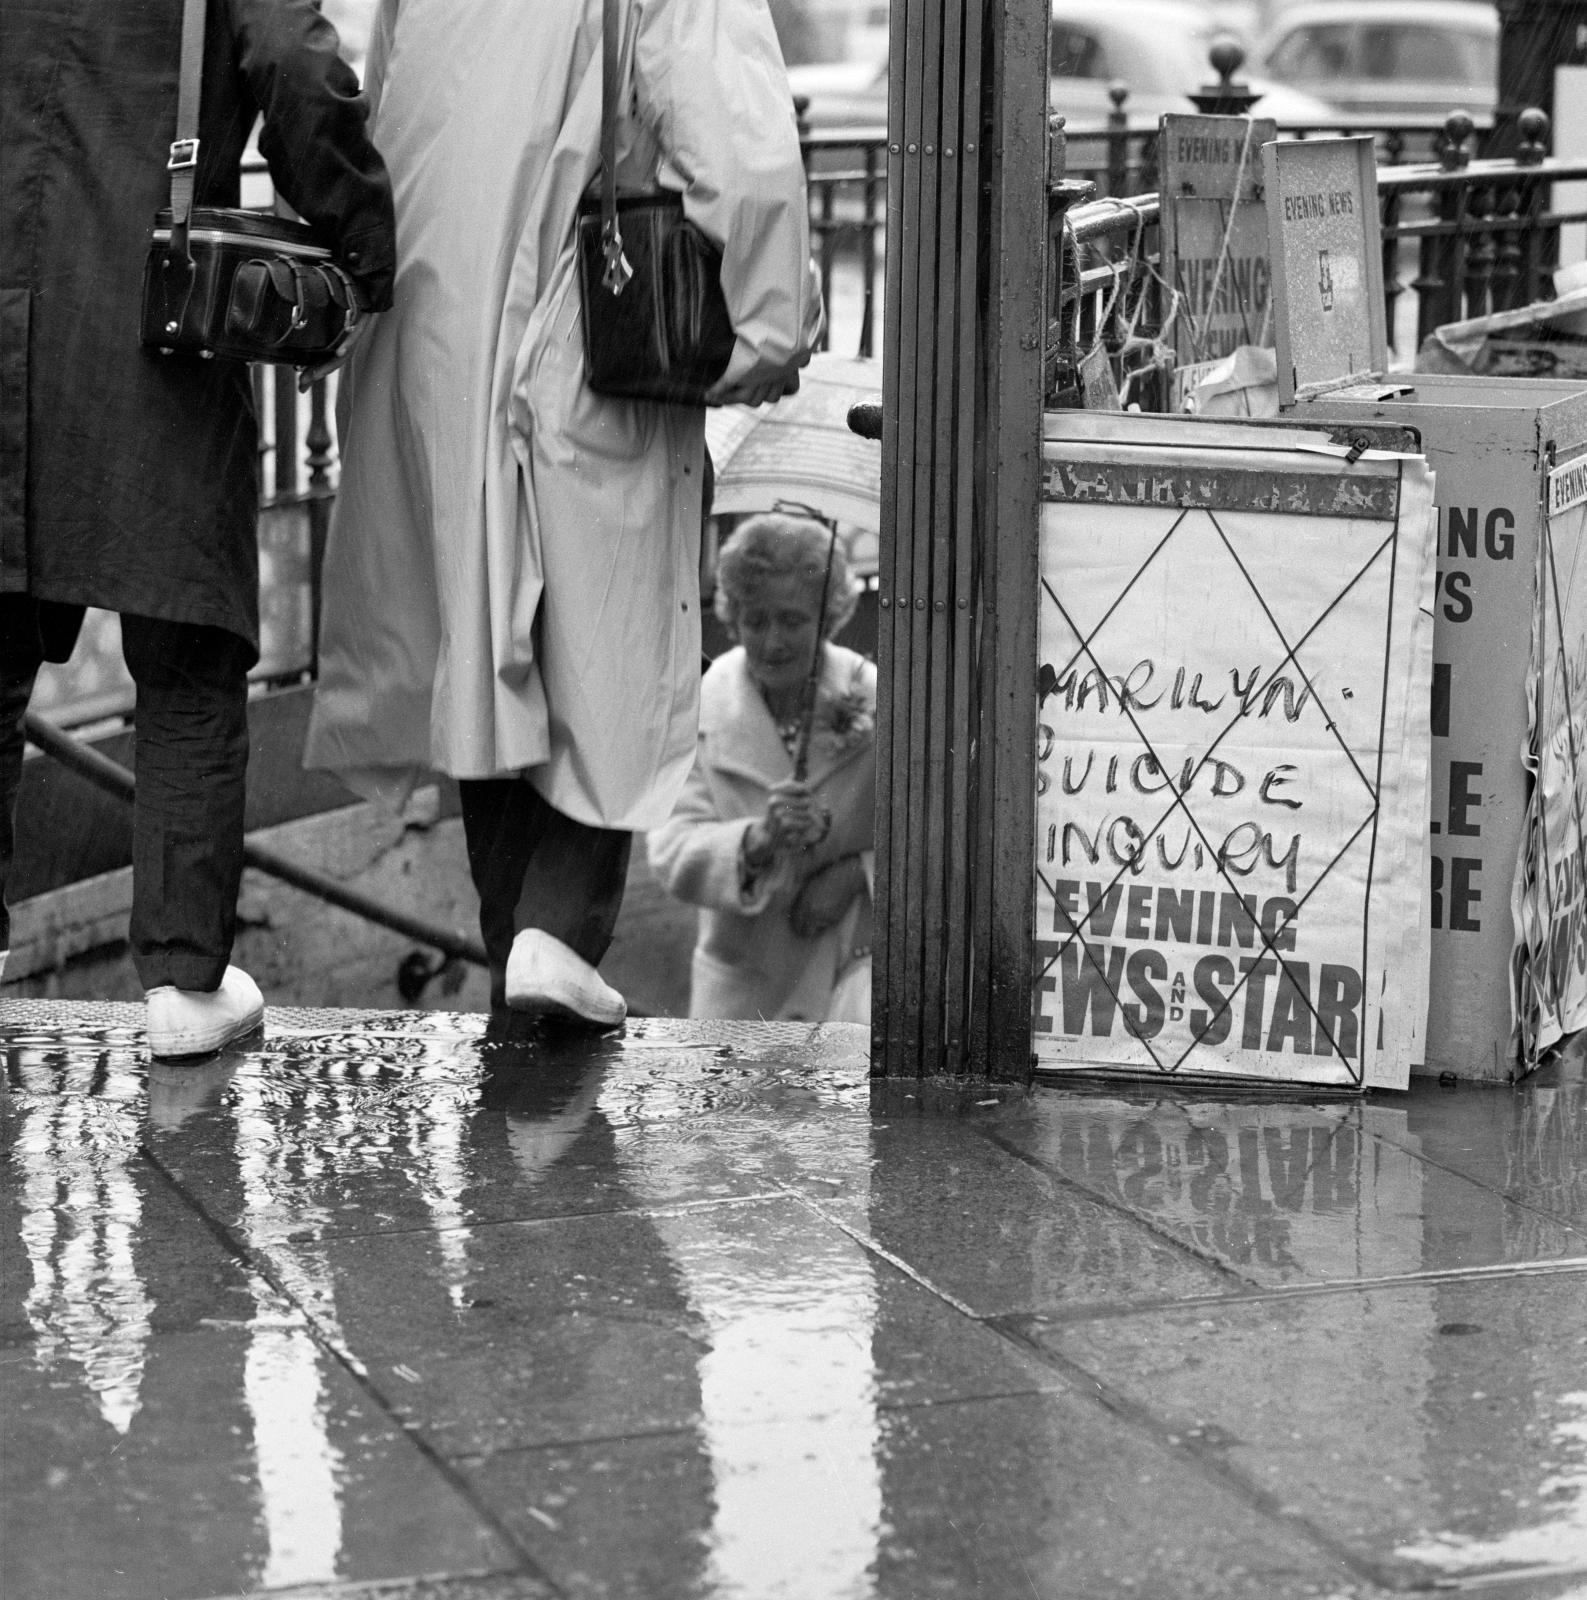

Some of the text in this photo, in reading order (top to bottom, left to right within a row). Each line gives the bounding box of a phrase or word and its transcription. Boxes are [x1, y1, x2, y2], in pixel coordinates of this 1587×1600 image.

[1178, 137, 1229, 162] EVENING
[1284, 191, 1353, 221] EVENING NEWS
[1436, 506, 1515, 560] NG
[1039, 658, 1318, 723] MARILYN
[1046, 813, 1301, 893] INQUIRY
[1053, 879, 1299, 953] EVENING
[1168, 971, 1186, 1023] AND
[1189, 954, 1363, 1060] STAR
